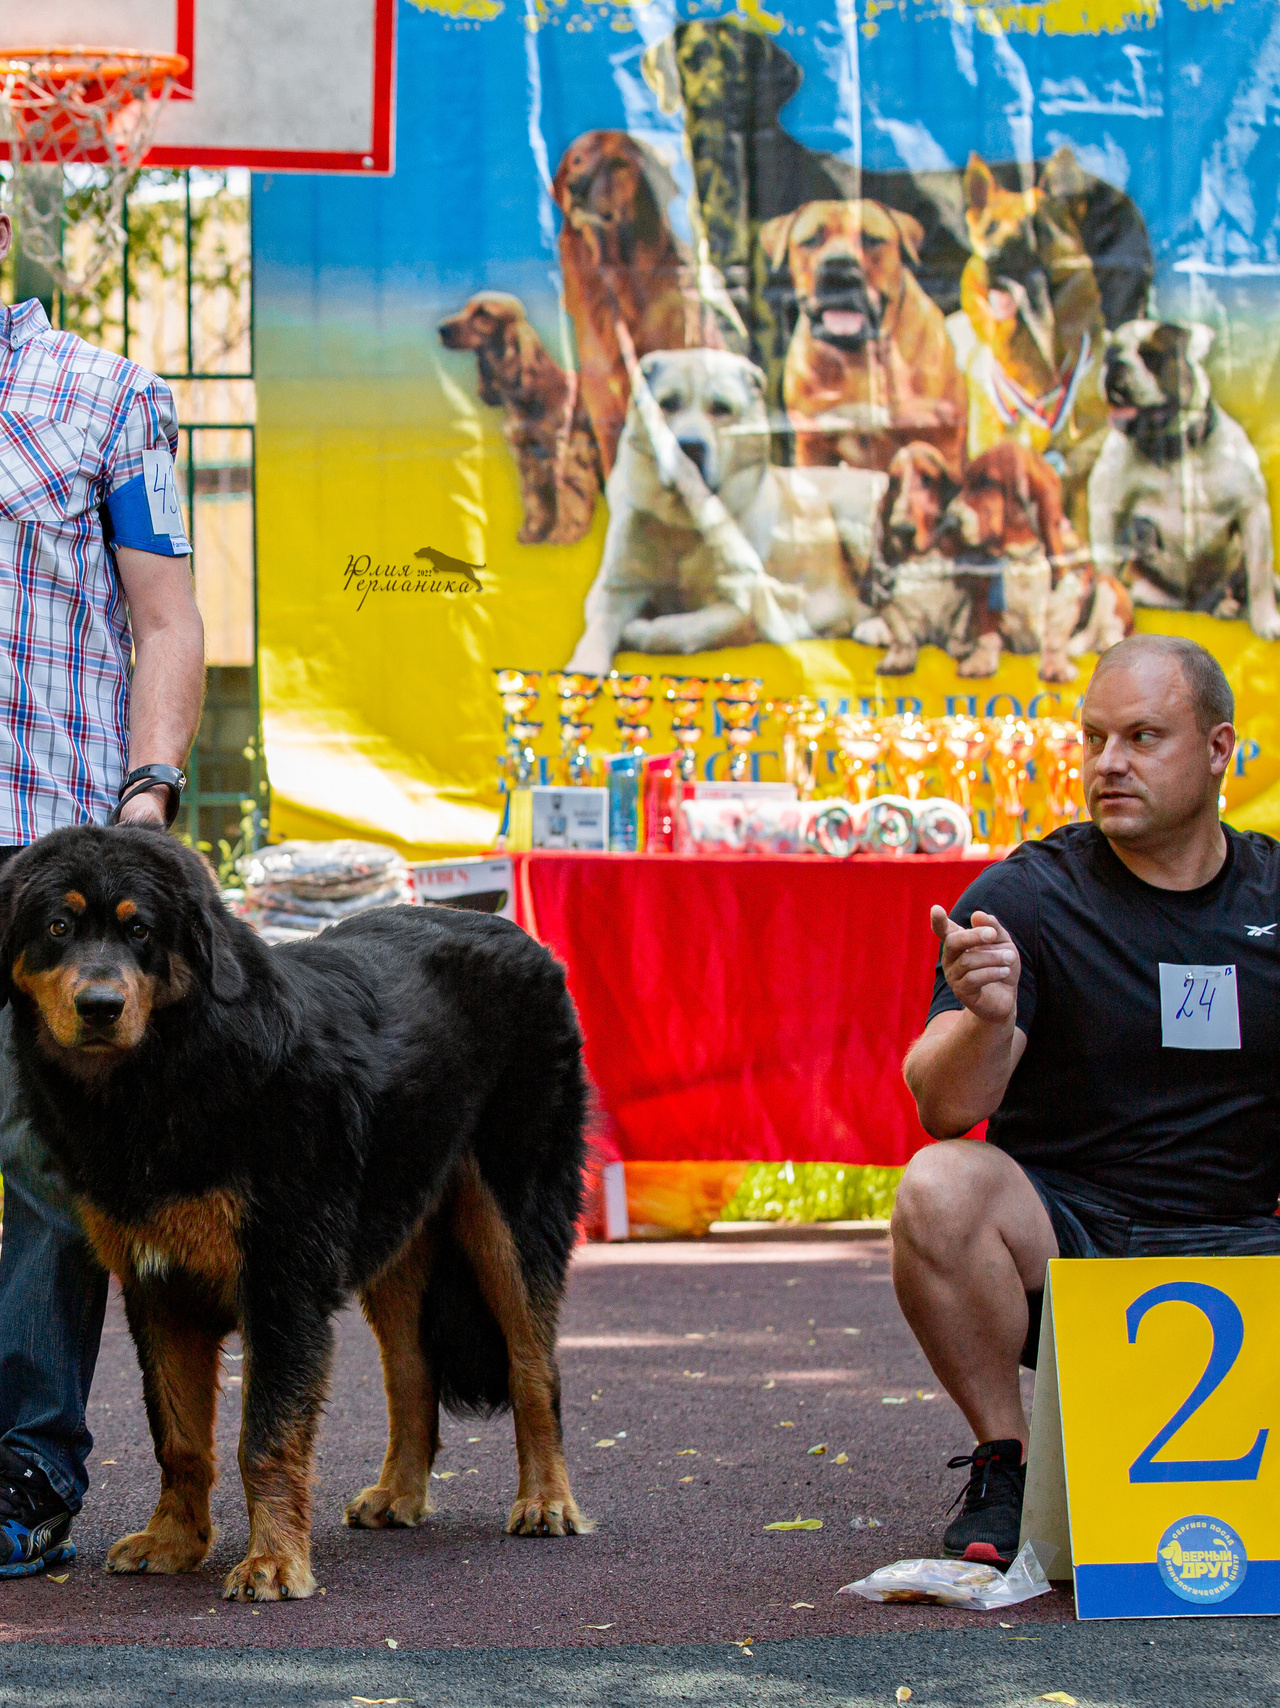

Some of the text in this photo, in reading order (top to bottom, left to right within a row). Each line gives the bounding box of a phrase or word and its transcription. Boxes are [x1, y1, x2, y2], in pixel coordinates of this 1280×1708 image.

[1175, 978, 1217, 1021] 24
[1125, 1281, 1269, 1484] 2
[1172, 1522, 1235, 1546] СЕРГИЕВ ПОСАД
[1179, 1561, 1233, 1579] ДРУГ
[1182, 1551, 1232, 1562] ВЕРНЫЙ
[1166, 1554, 1240, 1596] КИНОЛОГИЧЕСКИЙ ЦЕНТР
